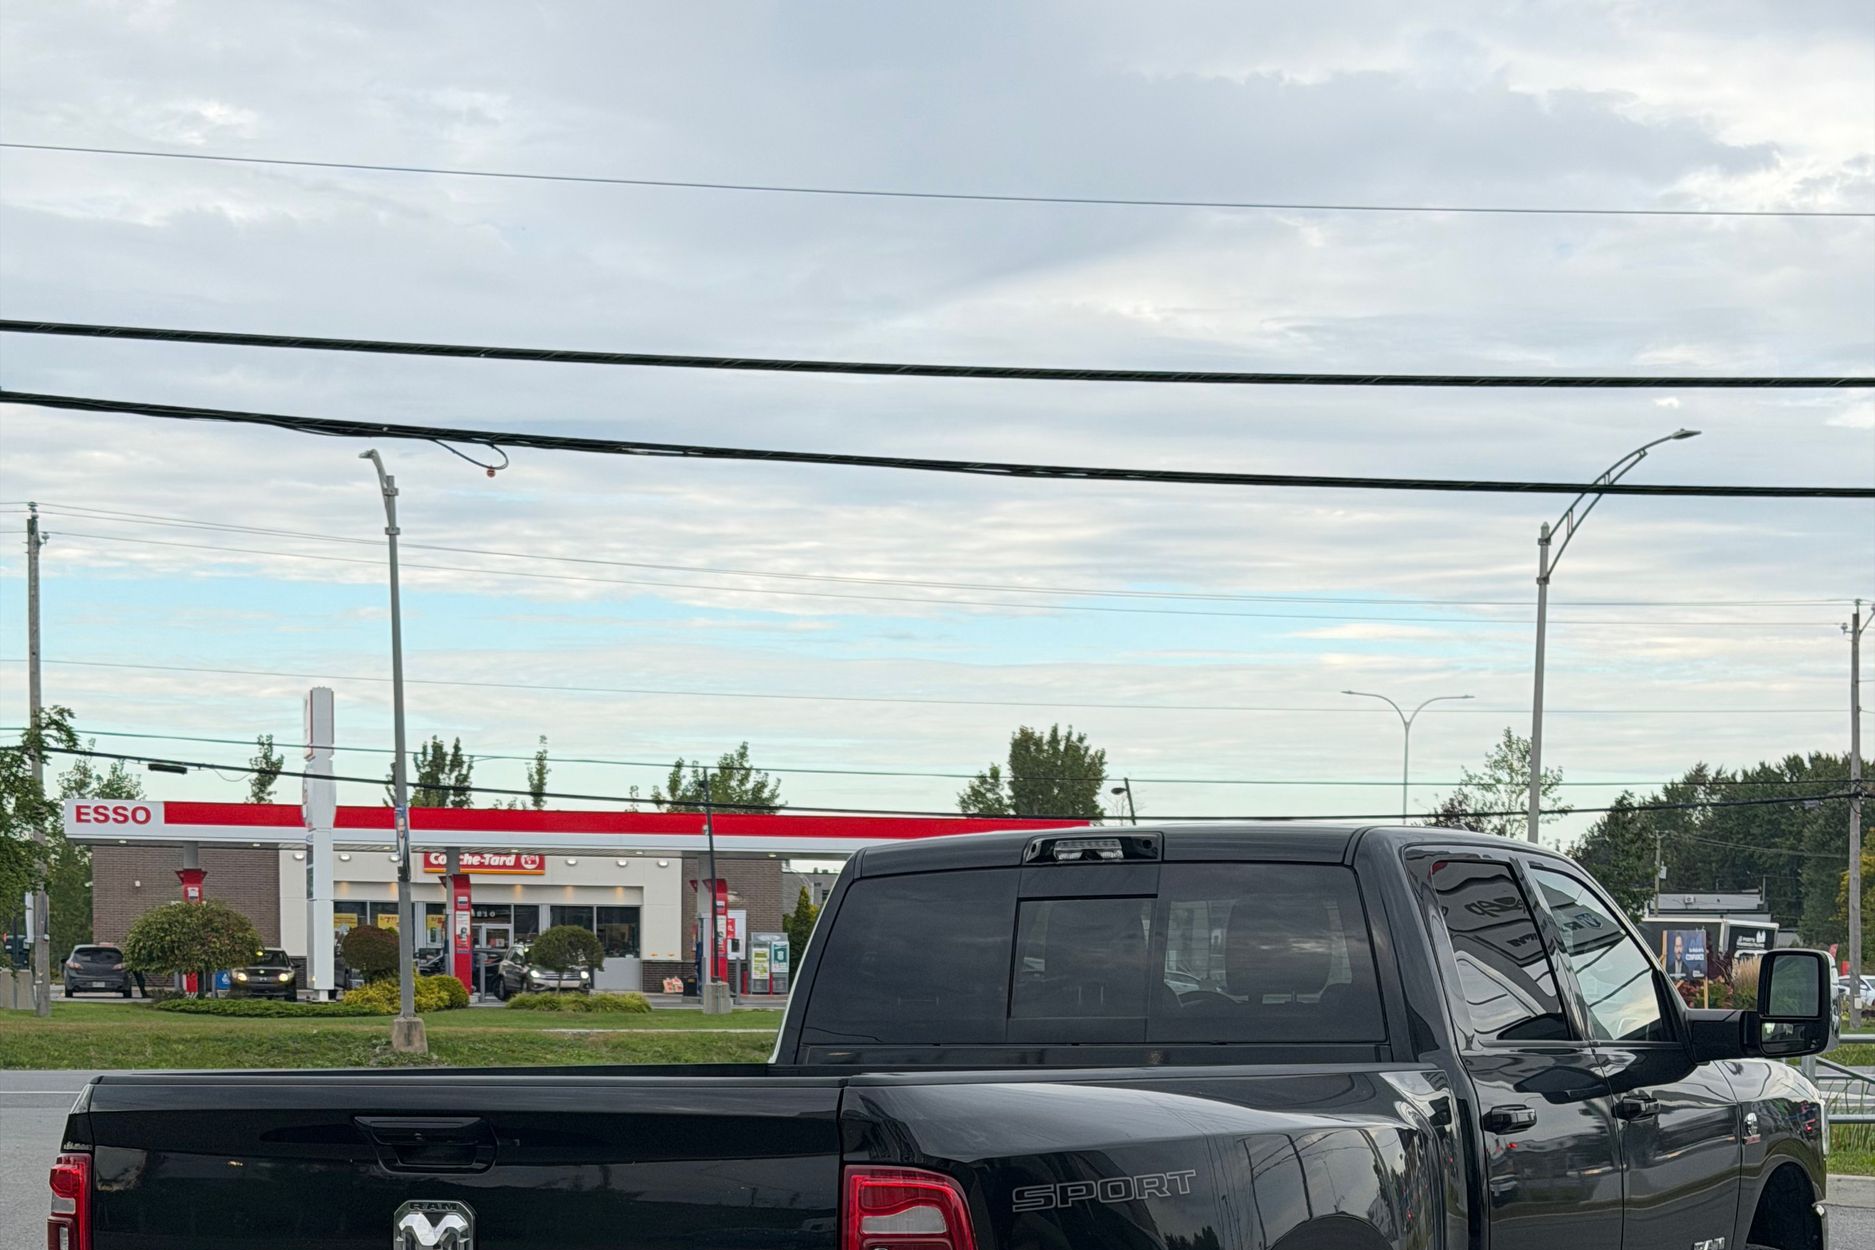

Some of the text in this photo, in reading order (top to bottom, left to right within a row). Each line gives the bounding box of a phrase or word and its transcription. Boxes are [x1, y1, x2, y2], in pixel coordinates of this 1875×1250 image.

[75, 805, 152, 825] ESSO
[429, 852, 516, 867] Cohe-Tard
[1012, 1169, 1196, 1213] SPORT
[409, 1202, 458, 1211] RAM
